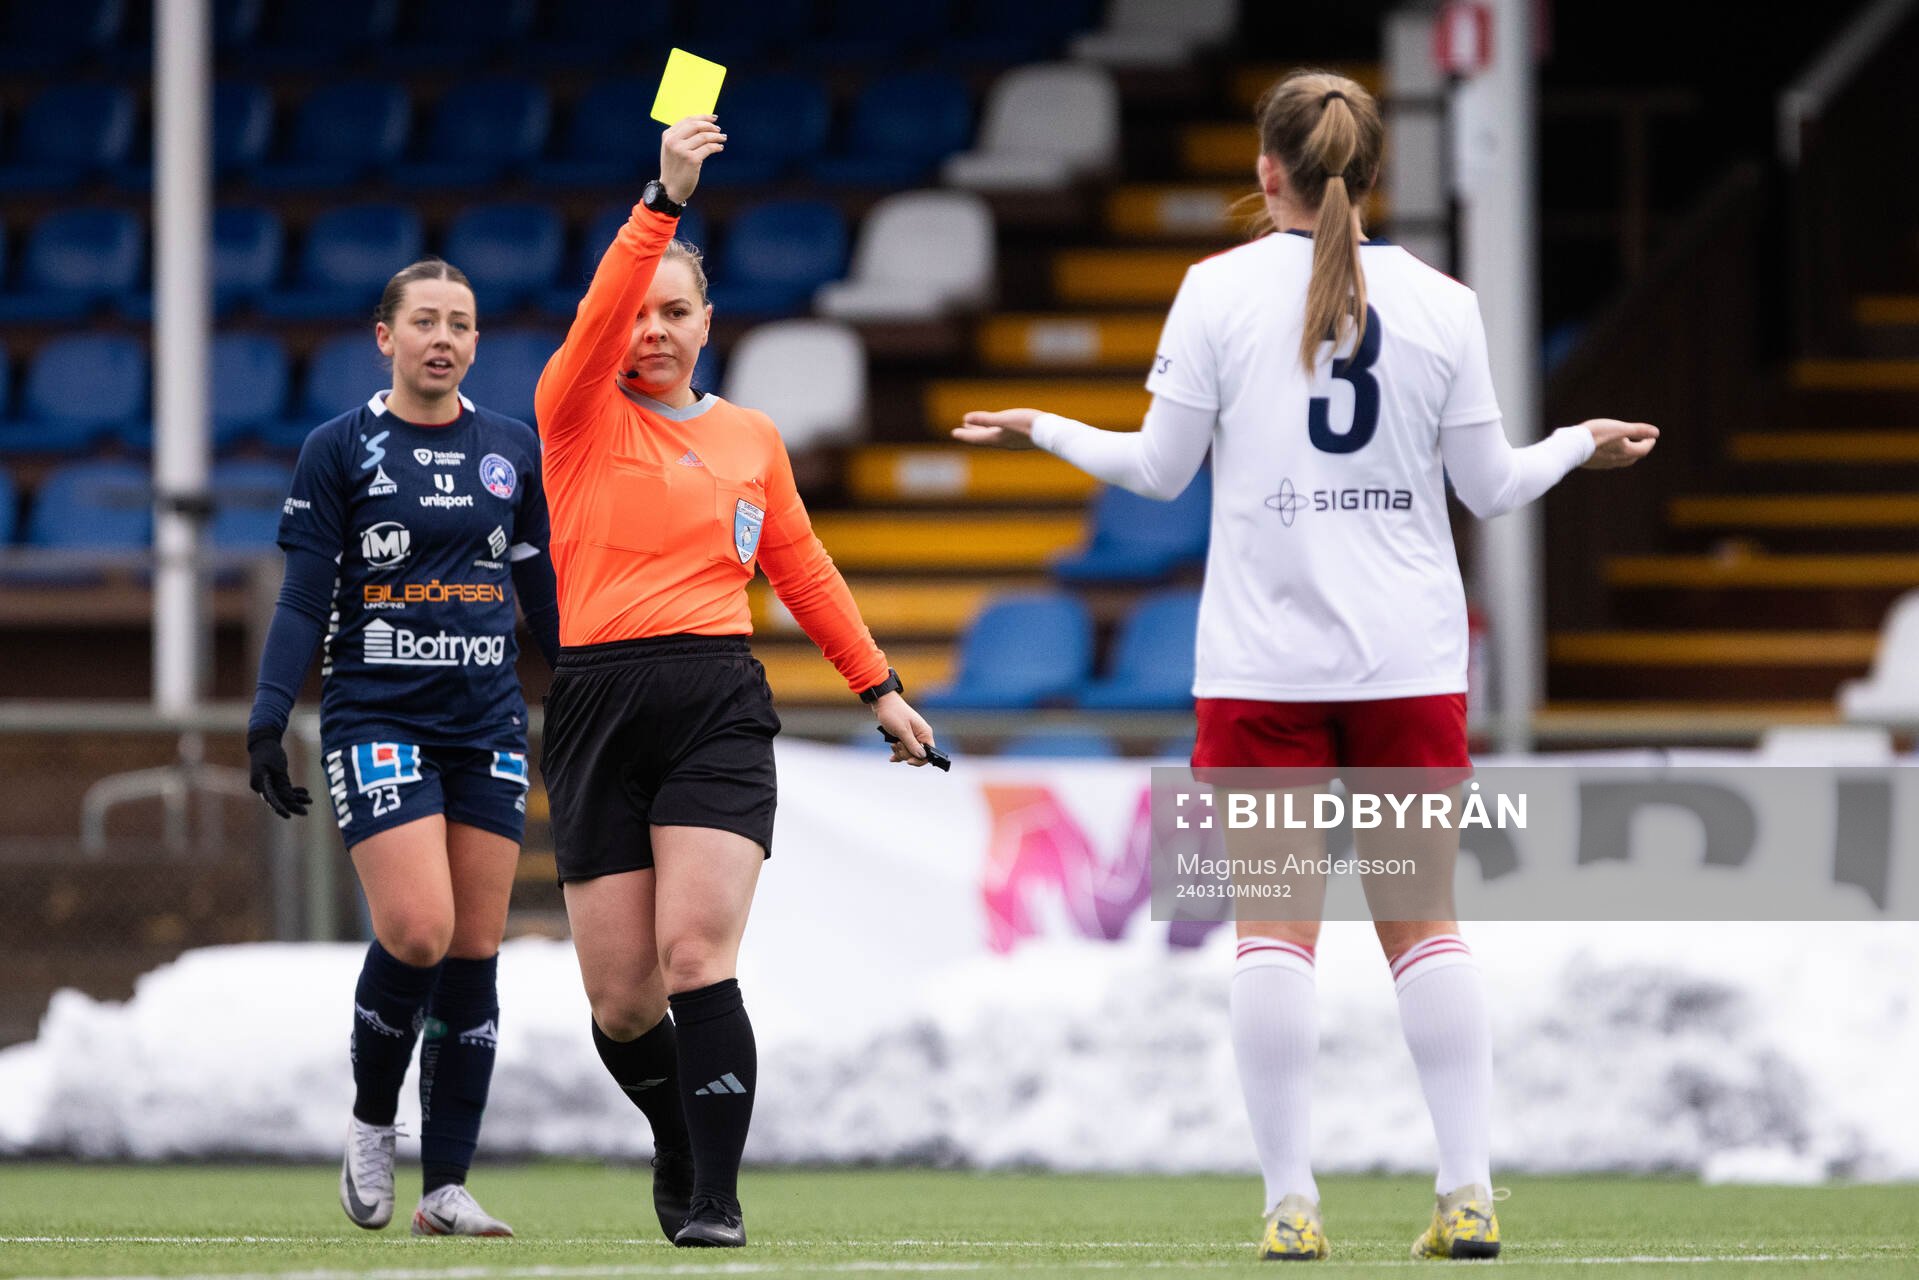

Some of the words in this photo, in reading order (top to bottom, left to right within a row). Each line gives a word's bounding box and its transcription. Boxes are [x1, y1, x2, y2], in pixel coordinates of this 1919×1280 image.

[1307, 302, 1382, 455] 3
[368, 484, 398, 496] SELECT
[419, 493, 474, 509] unisport
[363, 579, 504, 603] BILBÖRSEN
[396, 629, 505, 667] Botrygg
[367, 784, 401, 818] 23
